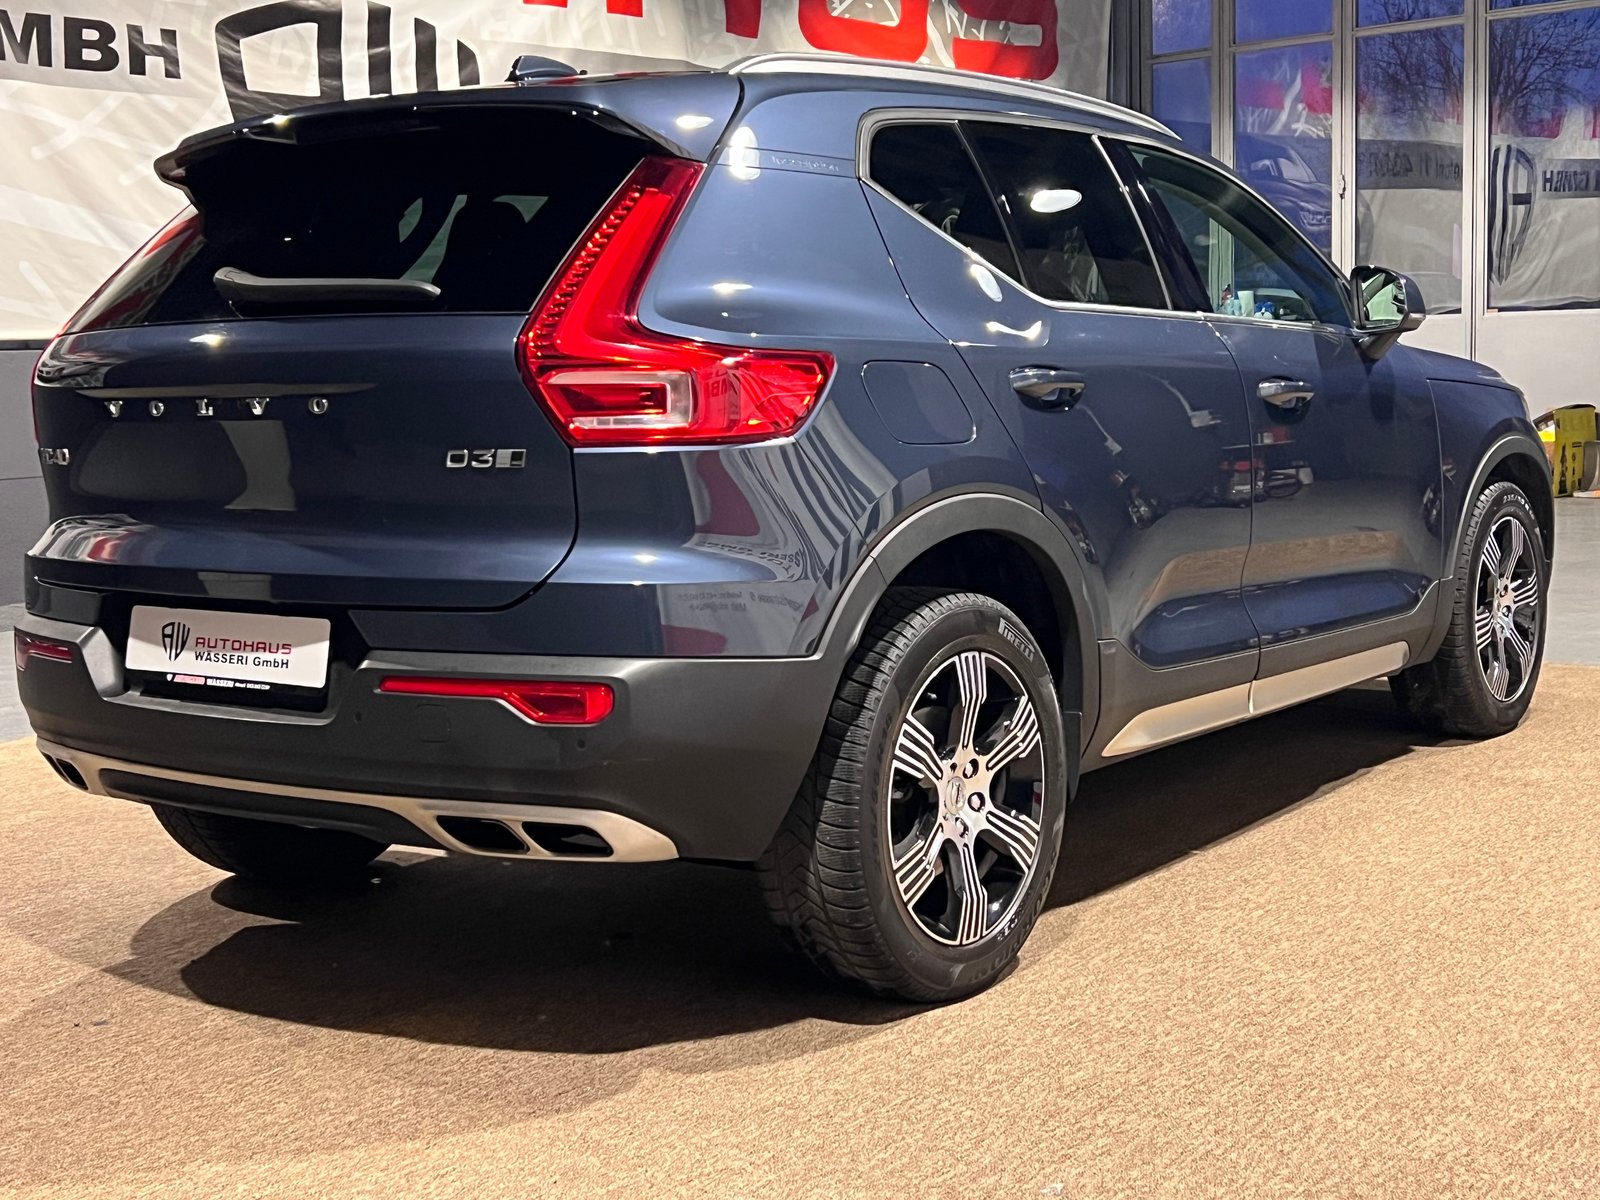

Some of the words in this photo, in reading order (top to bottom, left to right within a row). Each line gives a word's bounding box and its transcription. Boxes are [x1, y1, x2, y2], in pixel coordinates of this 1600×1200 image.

[0, 9, 181, 79] MBH
[104, 397, 328, 418] VOLVO
[446, 449, 495, 468] D3
[195, 636, 292, 655] AUTOHAUS
[998, 617, 1035, 662] PIRELLI
[194, 650, 248, 666] WÄSSERI
[252, 656, 290, 669] GmbH
